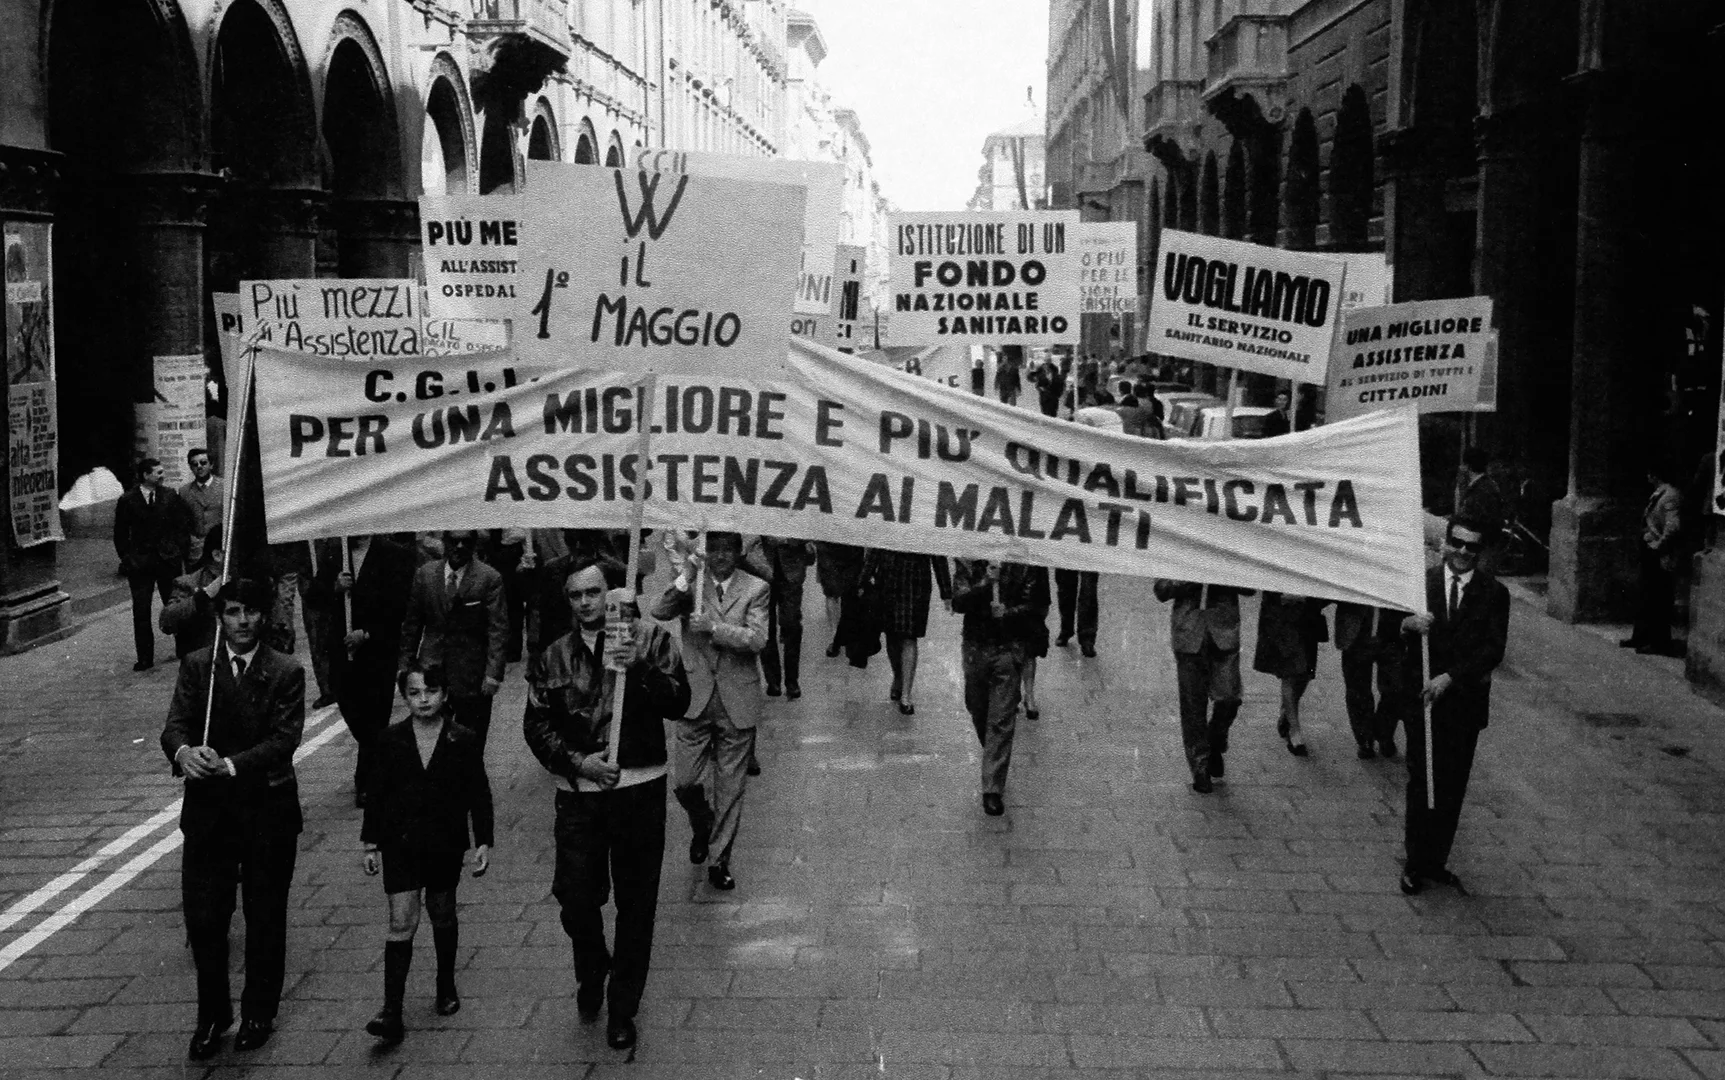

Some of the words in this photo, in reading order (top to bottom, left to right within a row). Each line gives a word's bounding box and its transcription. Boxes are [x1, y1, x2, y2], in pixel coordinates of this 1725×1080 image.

[614, 168, 688, 240] W
[479, 220, 518, 246] ME
[898, 222, 1005, 256] ISTITUZIONE
[1017, 222, 1034, 254] DI
[1043, 222, 1065, 254] UN
[441, 260, 517, 274] ALL'ASSIST
[914, 259, 1047, 288] FONDO
[896, 292, 1039, 312] NAZIONALE
[1164, 252, 1331, 328] VOGLIAMO
[591, 292, 742, 348] MAGGIO
[937, 315, 1068, 335] SANITARIO
[1188, 313, 1204, 328] IL
[1207, 316, 1293, 344] SERVIZIO
[1346, 325, 1382, 345] UNA
[1387, 316, 1482, 339] MIGLIORE
[1165, 328, 1234, 350] SANITARIO
[1236, 342, 1311, 364] NAZIONALE
[1353, 343, 1465, 369] ASSISTENZA
[1358, 371, 1409, 385] SERVIZIO
[1358, 383, 1448, 403] CITTADINI
[290, 414, 389, 458] PER
[412, 401, 516, 449] UNA
[543, 385, 787, 440] MIGLIORE
[815, 399, 844, 447] E
[1005, 441, 1363, 528] QUALIFICATA
[484, 453, 834, 514] ASSISTENZA
[855, 472, 914, 524] AI
[935, 481, 1152, 550] MALATI
